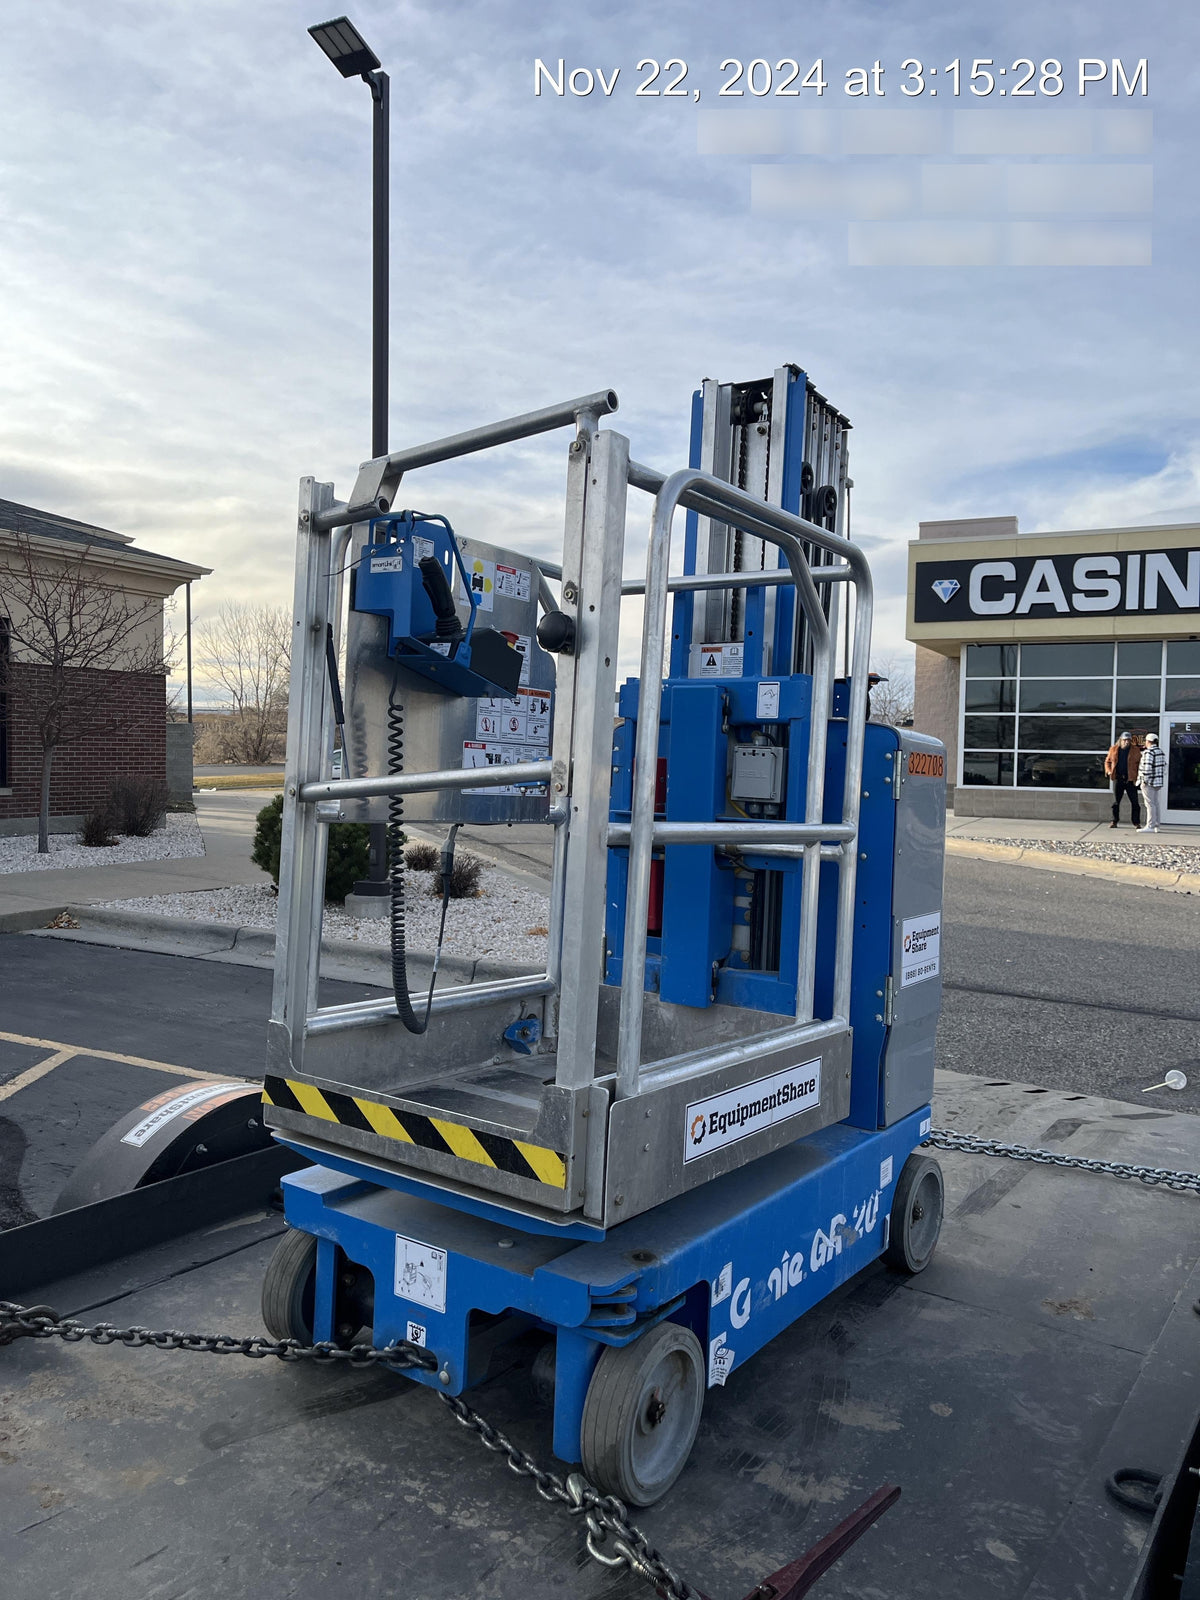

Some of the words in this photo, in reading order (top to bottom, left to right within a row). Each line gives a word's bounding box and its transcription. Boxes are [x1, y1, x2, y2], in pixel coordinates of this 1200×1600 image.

[968, 550, 1200, 616] CASIN
[908, 751, 944, 777] 322708
[911, 925, 940, 943] Equipment
[911, 941, 928, 954] Share
[708, 1077, 816, 1136] EquipmentShare
[729, 1250, 804, 1330] Gnie
